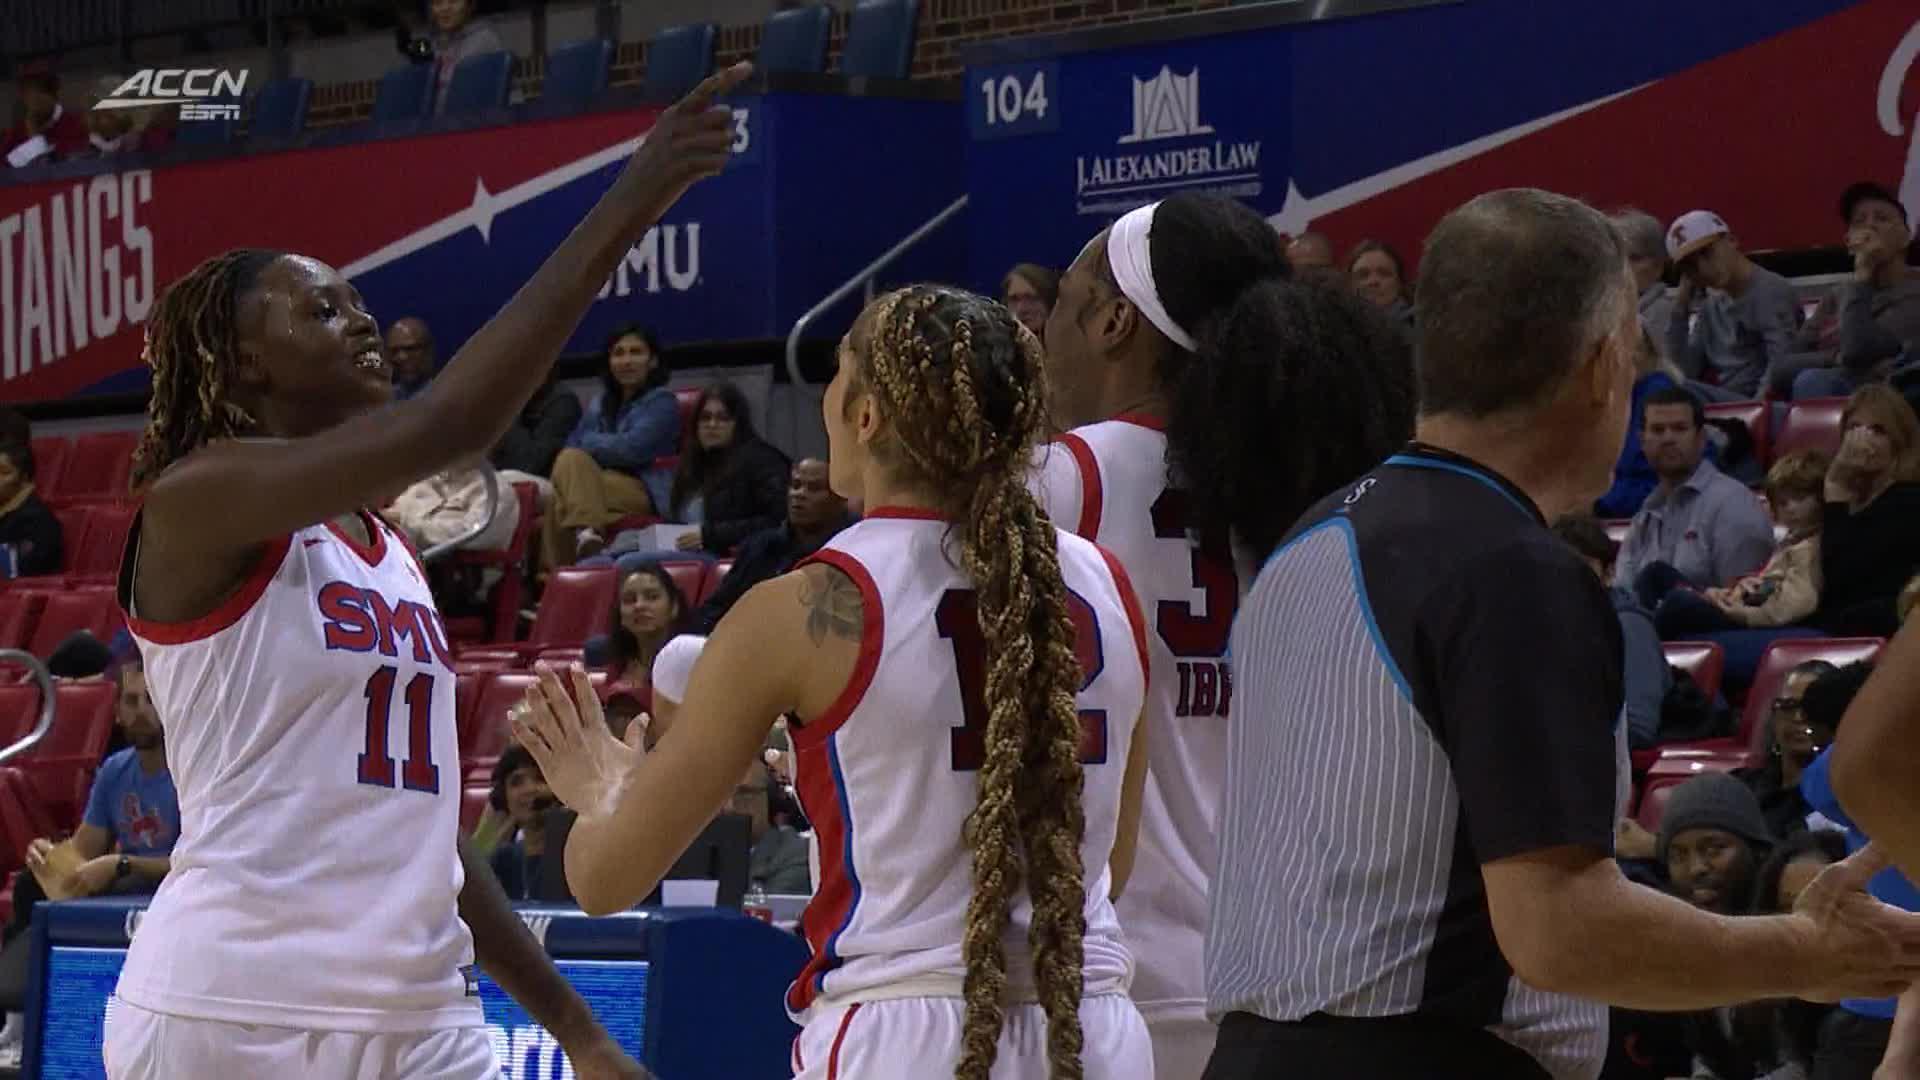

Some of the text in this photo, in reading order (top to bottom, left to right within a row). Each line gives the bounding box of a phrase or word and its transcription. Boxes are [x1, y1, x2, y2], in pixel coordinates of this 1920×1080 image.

[982, 71, 1049, 125] 104
[1215, 140, 1261, 171] LAW
[0, 169, 154, 382] TANGS
[597, 223, 700, 299] MU
[318, 581, 456, 674] SMU
[358, 664, 439, 795] 11
